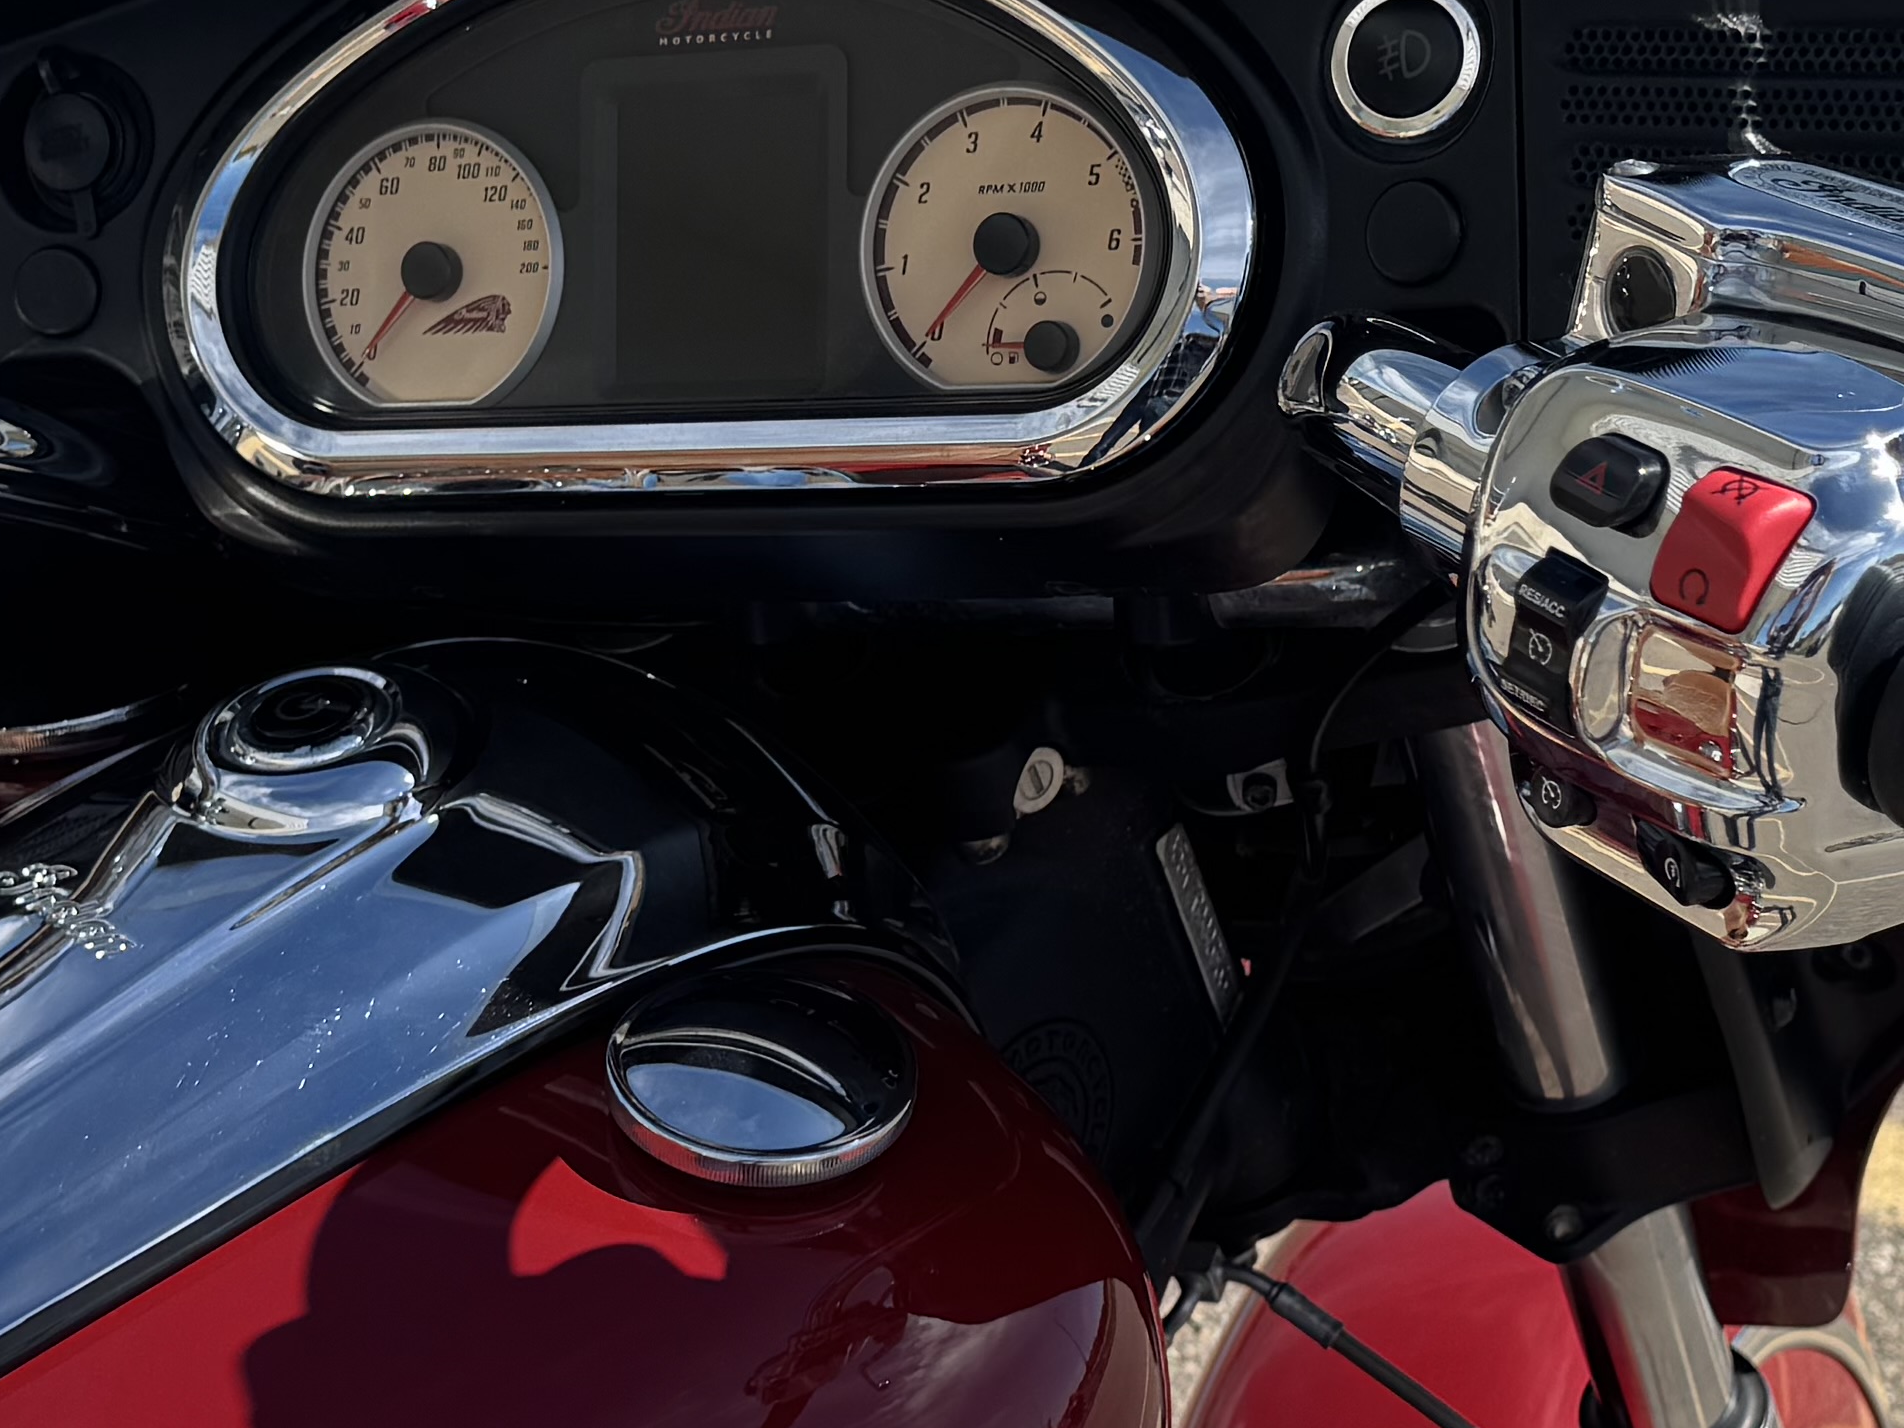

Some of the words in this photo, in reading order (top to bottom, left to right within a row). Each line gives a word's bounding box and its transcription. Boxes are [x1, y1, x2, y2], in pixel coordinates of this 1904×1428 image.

[659, 28, 773, 46] MOTORCYCLE
[1030, 121, 1044, 143] 4
[966, 132, 979, 154] 3
[404, 156, 416, 168] 70
[428, 156, 446, 172] 80
[457, 162, 480, 180] 100
[485, 166, 501, 177] 110
[1087, 164, 1102, 186] 5
[379, 177, 400, 196] 60
[483, 185, 508, 203] 120
[917, 182, 931, 204] 2
[978, 183, 1004, 195] RPM
[1019, 181, 1045, 193] 1000
[359, 198, 372, 210] 50
[510, 198, 527, 210] 140
[517, 219, 533, 230] 160
[344, 226, 365, 245] 40
[1107, 228, 1122, 251] 6
[523, 240, 539, 251] 180
[337, 260, 350, 272] 30
[520, 262, 539, 274] 200
[901, 253, 909, 275] 1
[340, 288, 360, 306] 20
[350, 323, 361, 335] 10
[1518, 583, 1566, 619] RES/ACC
[1500, 678, 1545, 713] SET/DEC
